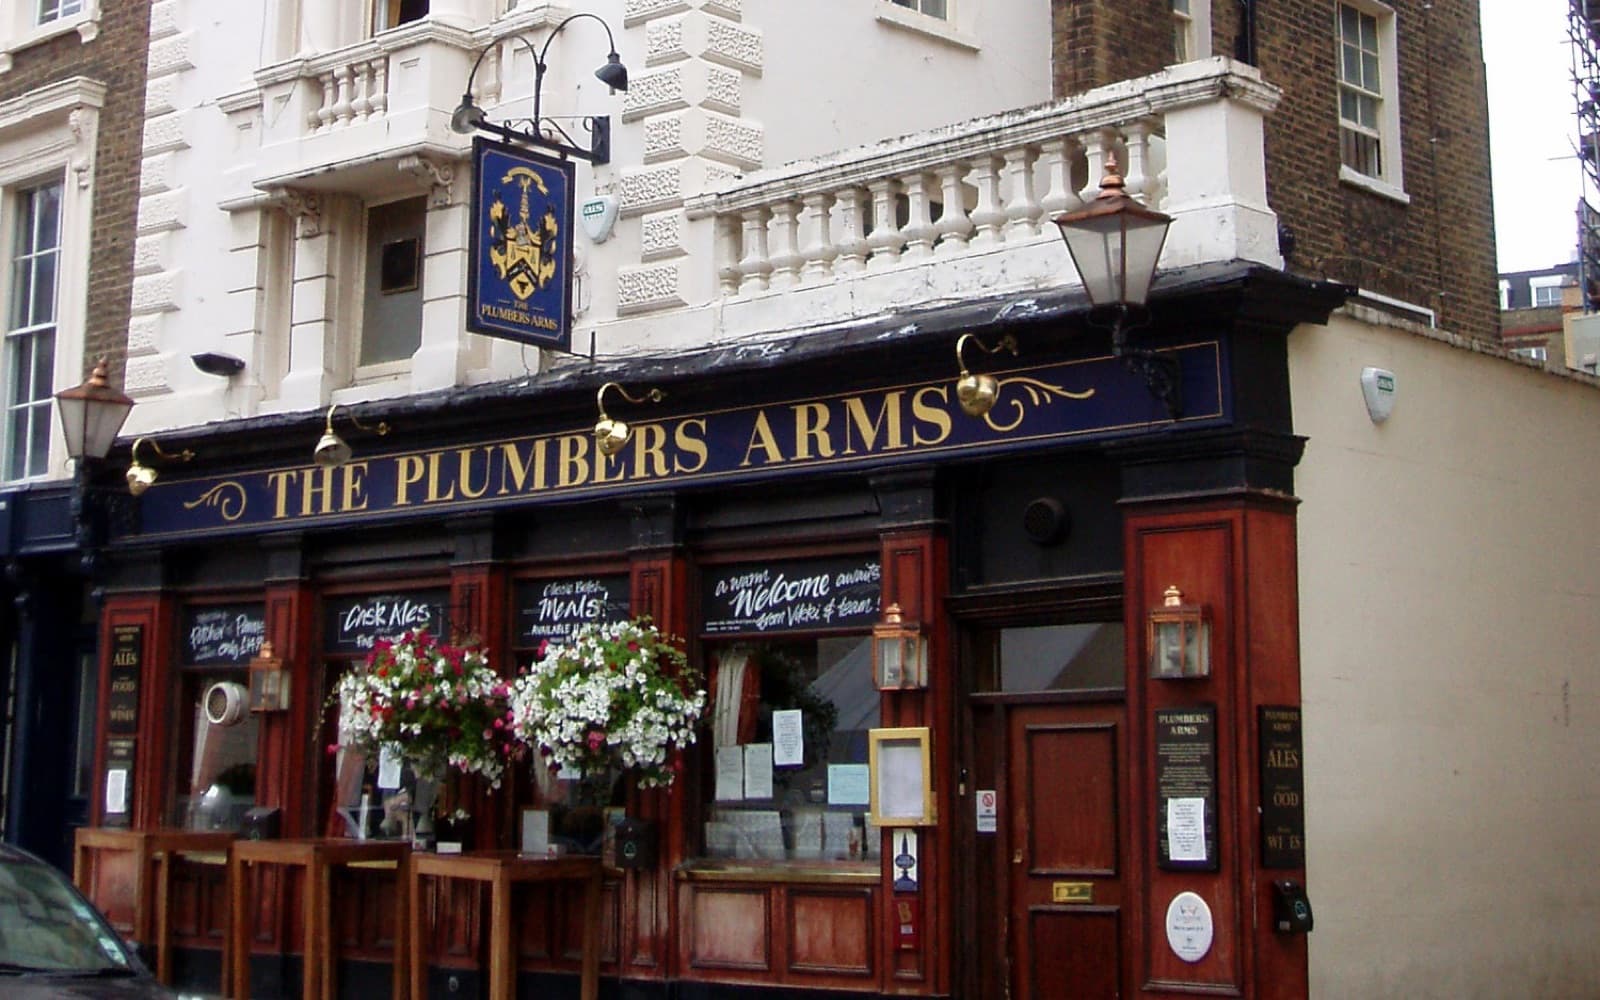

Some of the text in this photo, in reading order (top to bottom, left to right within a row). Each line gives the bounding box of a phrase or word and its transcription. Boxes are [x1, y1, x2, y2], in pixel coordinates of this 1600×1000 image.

[481, 304, 558, 330] PLUMBERS ARMS
[267, 386, 952, 519] THE PLUMBERS ARMS
[730, 569, 770, 591] warm
[729, 573, 830, 617] Welcome
[1158, 714, 1209, 724] PLUMBERS
[1170, 726, 1198, 735] ARMS
[1267, 750, 1298, 768] ALES
